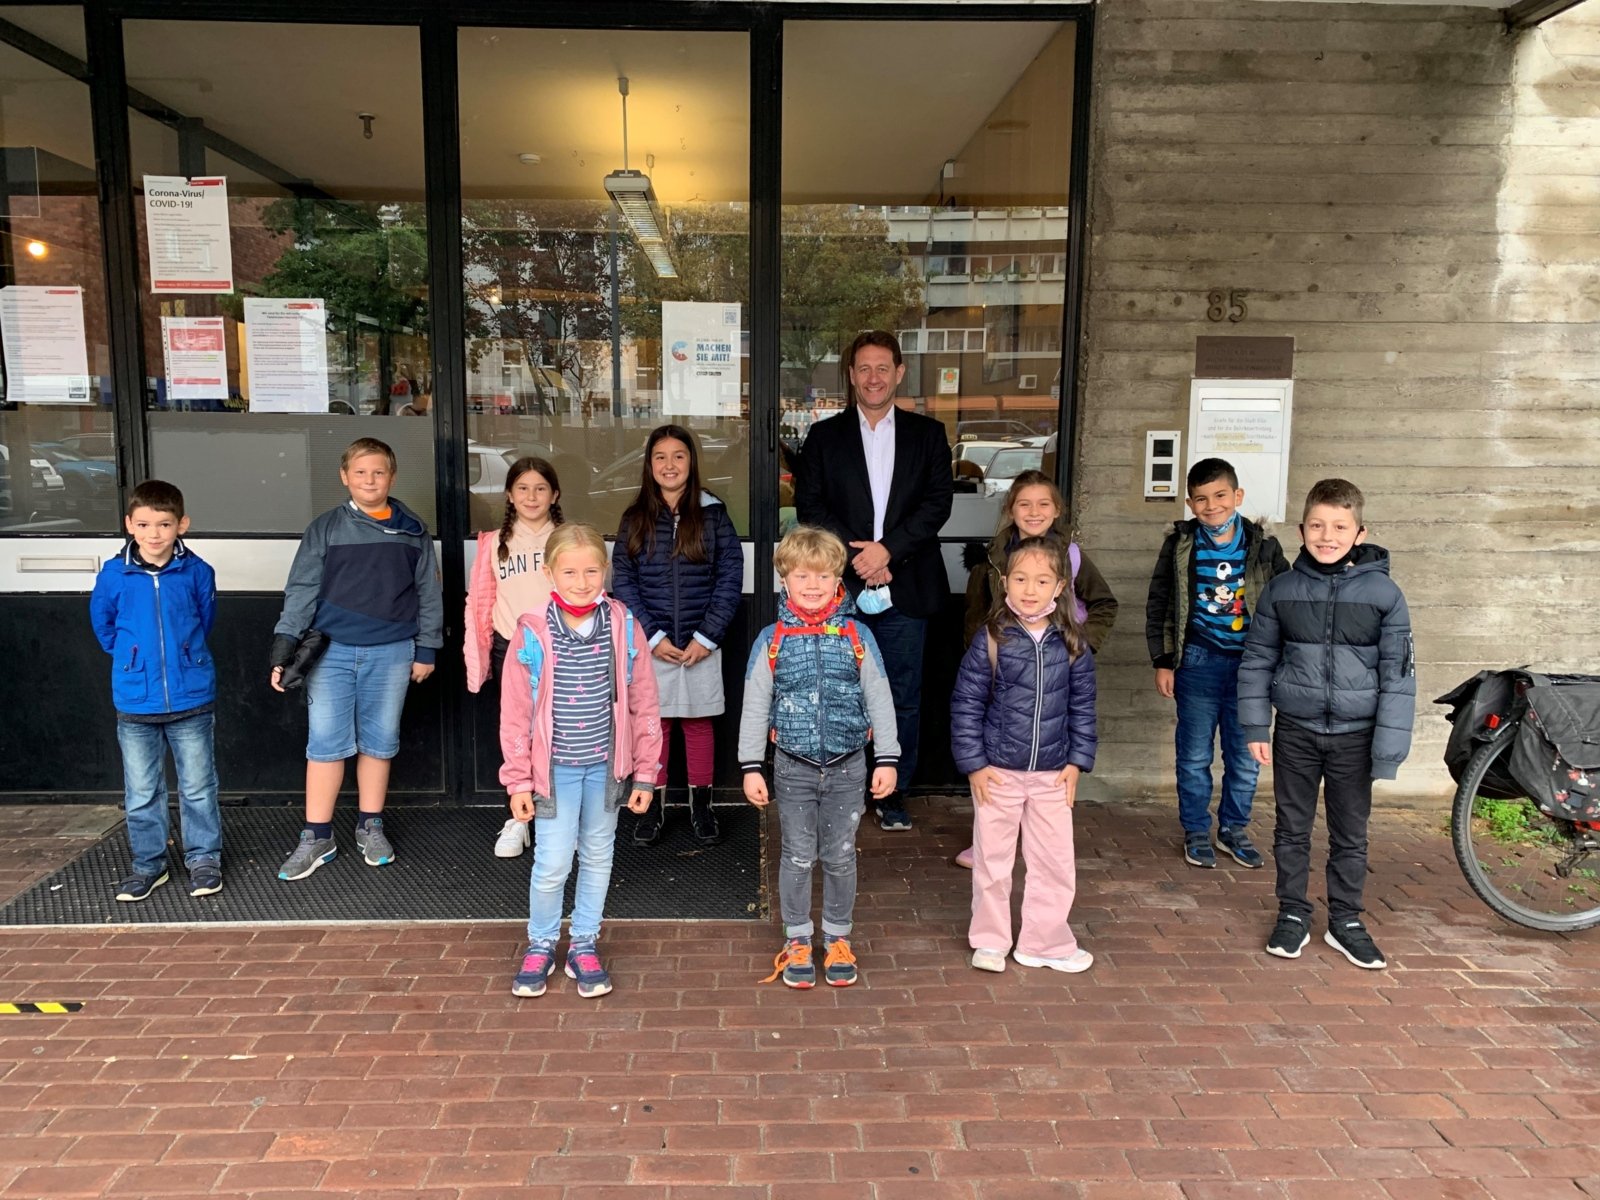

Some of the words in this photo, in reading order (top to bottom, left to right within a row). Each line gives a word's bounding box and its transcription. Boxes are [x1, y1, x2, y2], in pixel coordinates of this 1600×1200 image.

[149, 188, 205, 199] Corona-Virus/
[149, 199, 193, 209] COVID-19!
[1207, 290, 1248, 322] 85
[696, 343, 732, 352] MACHEN
[696, 353, 709, 362] SIE
[711, 353, 730, 362] MIT!
[499, 553, 527, 580] SAN
